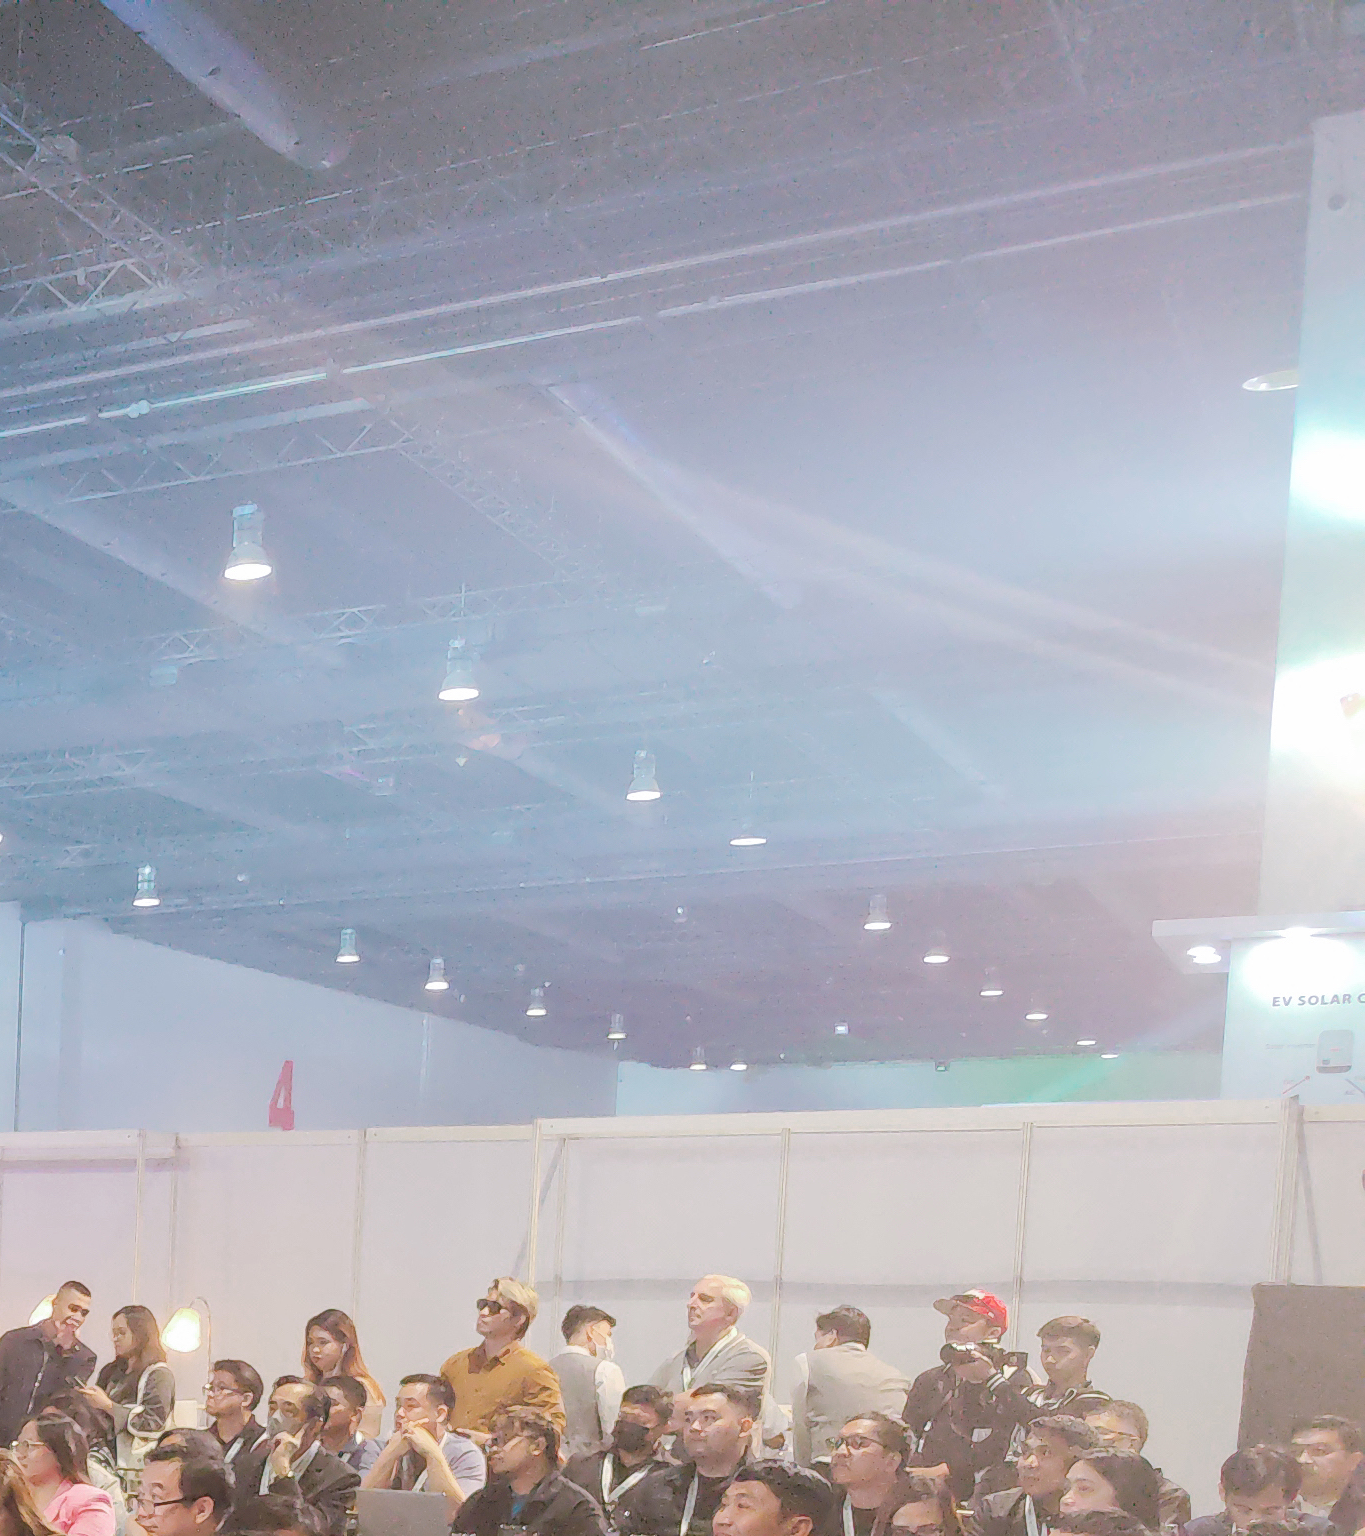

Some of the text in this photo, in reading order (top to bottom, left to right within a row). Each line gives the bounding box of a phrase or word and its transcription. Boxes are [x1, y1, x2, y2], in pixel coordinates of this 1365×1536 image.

[1272, 996, 1292, 1007] EV
[1297, 993, 1352, 1006] SOLAR
[269, 1060, 294, 1131] 4
